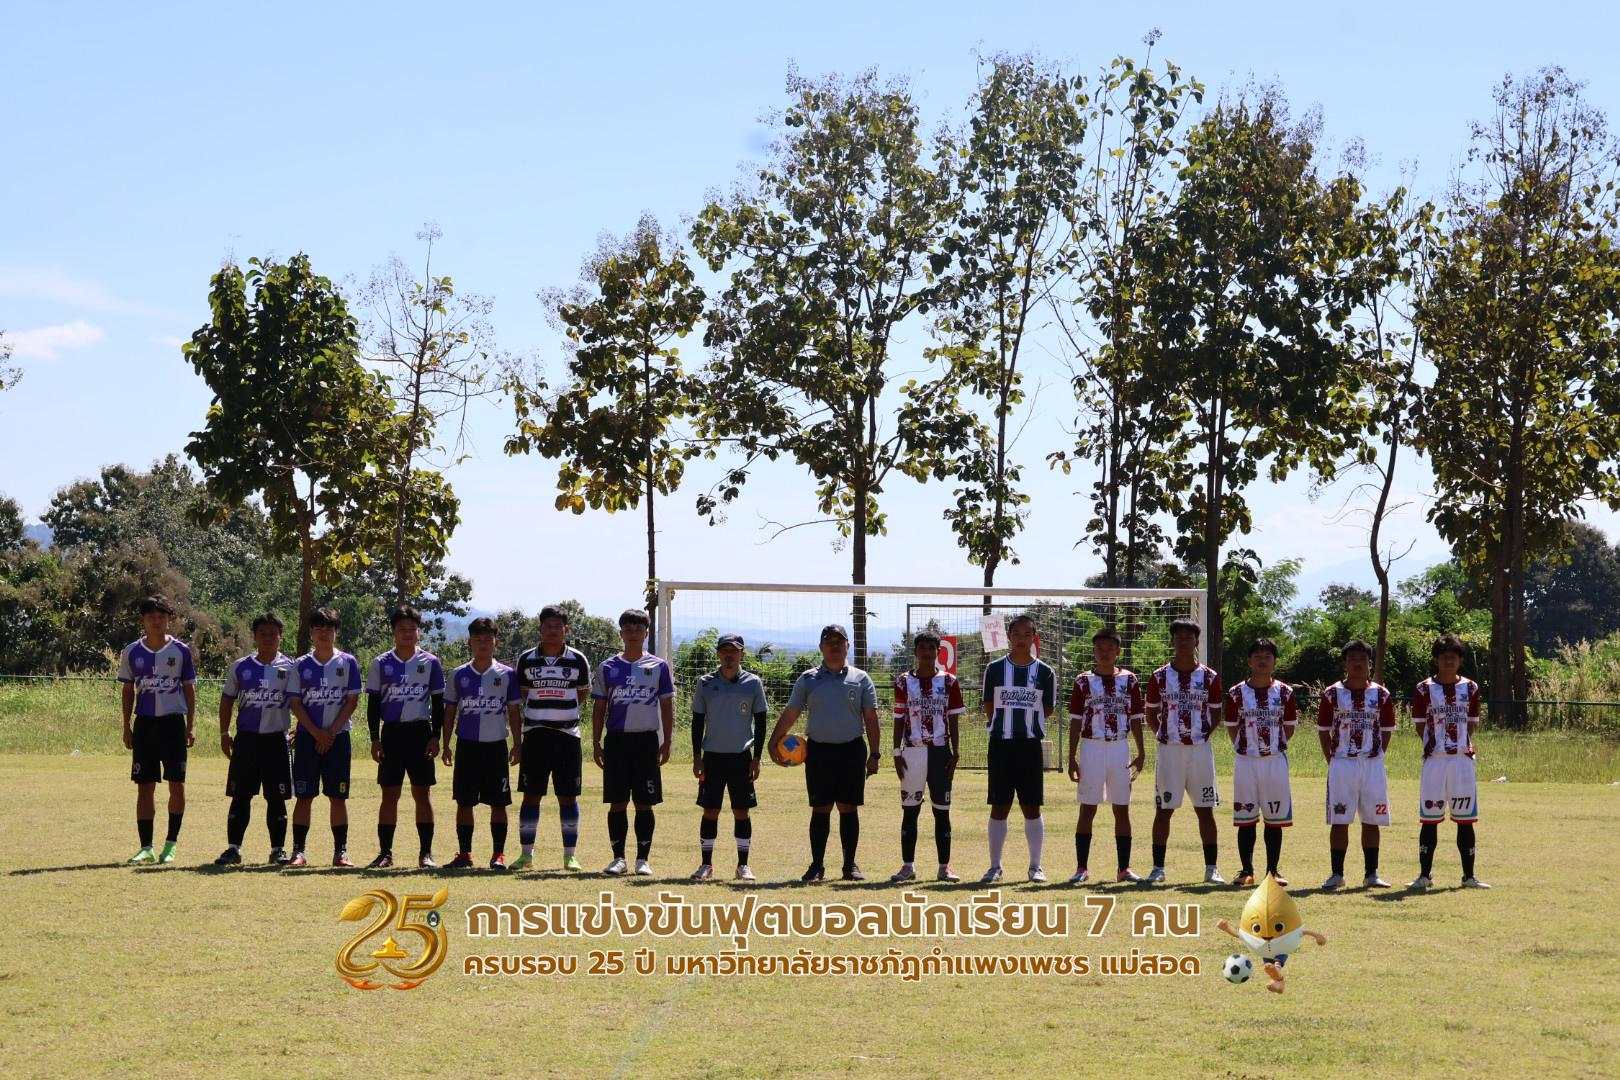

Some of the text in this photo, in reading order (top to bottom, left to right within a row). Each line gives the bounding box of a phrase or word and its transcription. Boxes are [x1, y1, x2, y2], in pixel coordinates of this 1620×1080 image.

[1267, 801, 1281, 814] 17
[1375, 804, 1387, 815] 22
[1451, 797, 1471, 810] 777
